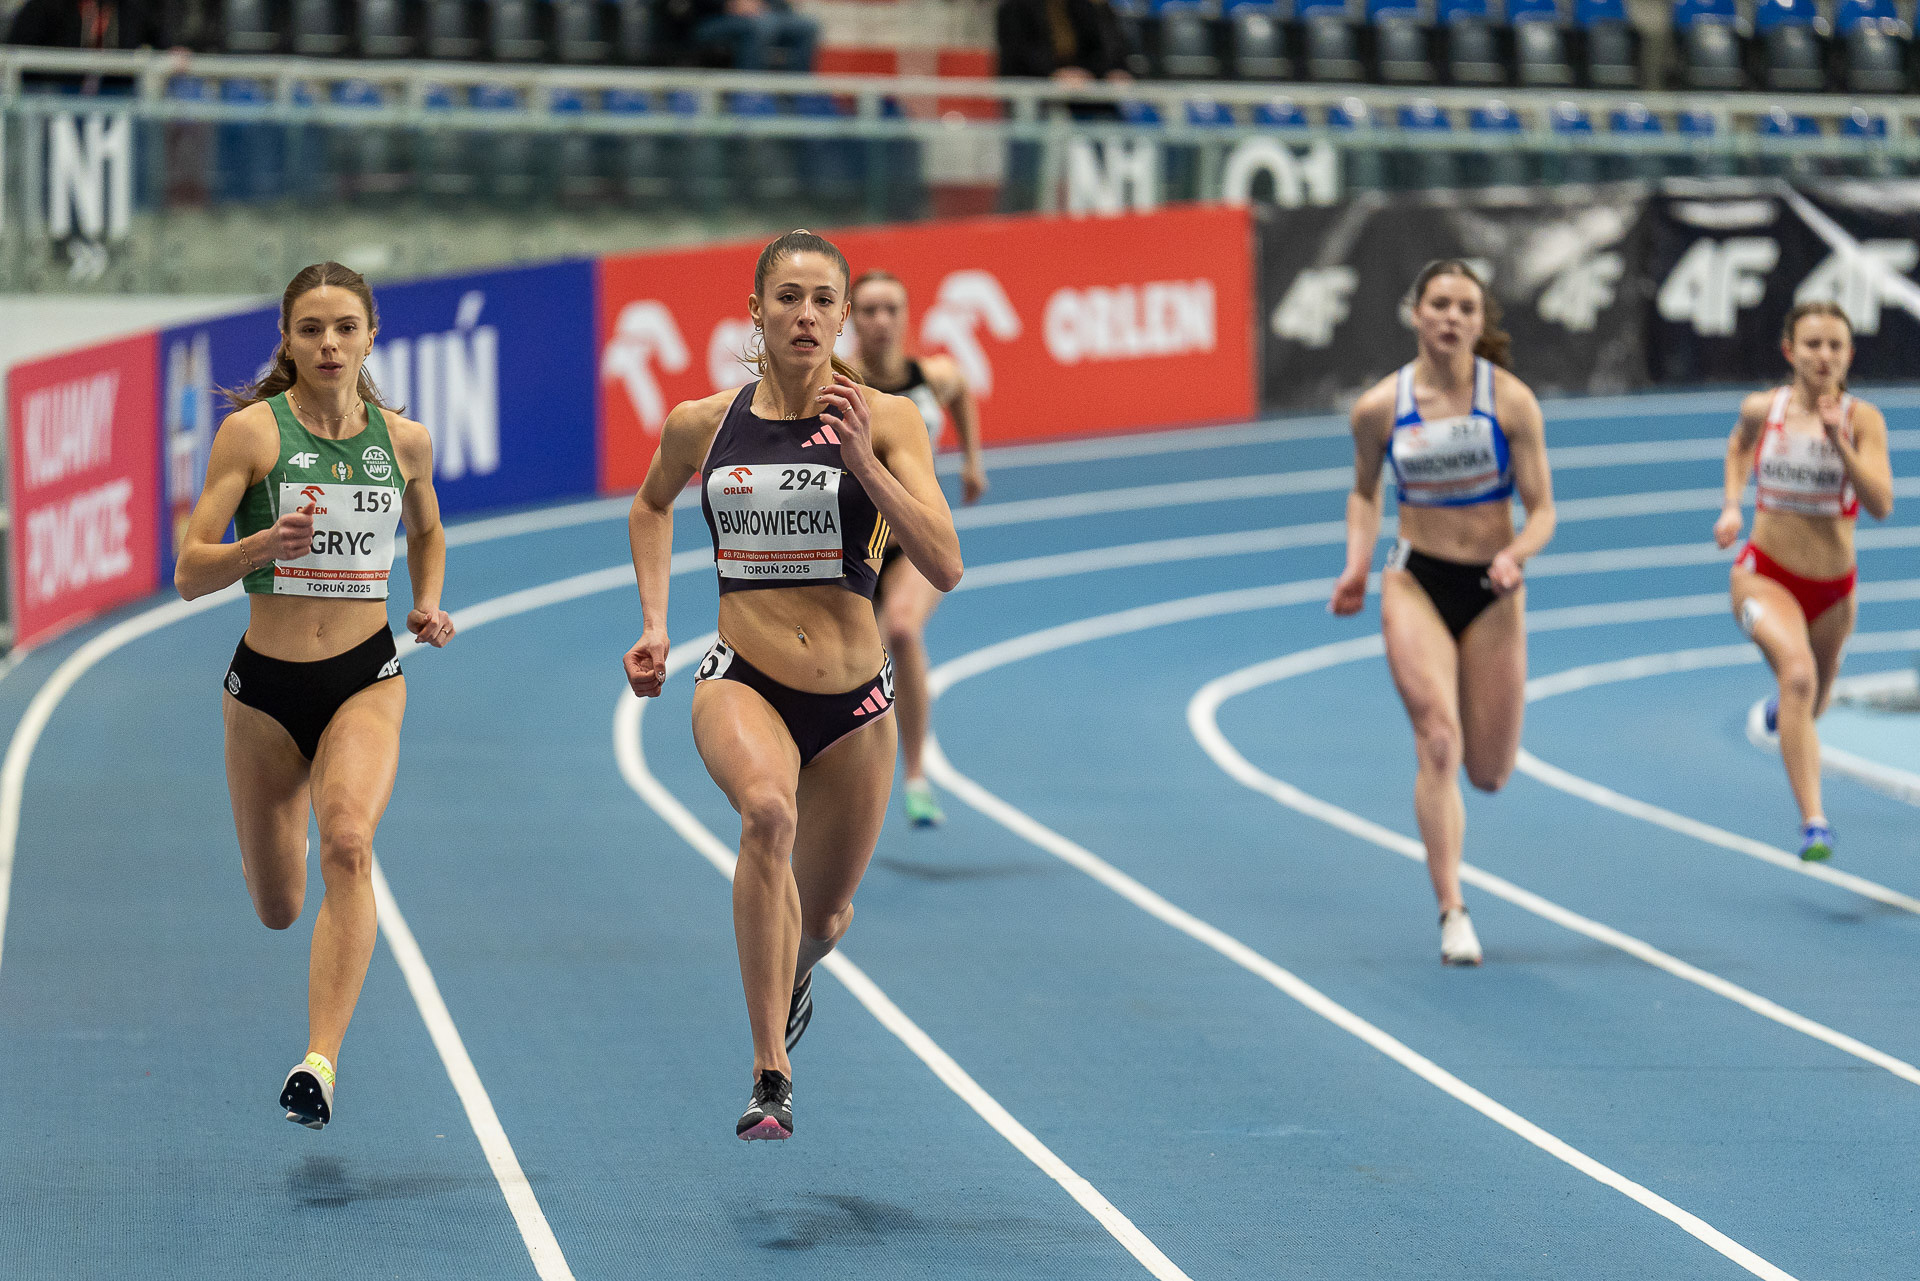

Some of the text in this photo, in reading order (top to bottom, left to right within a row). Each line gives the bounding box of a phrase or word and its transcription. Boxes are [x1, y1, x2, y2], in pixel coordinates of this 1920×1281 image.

[1655, 237, 1782, 337] 4F
[1043, 278, 1216, 364] ORLEN
[288, 452, 319, 468] 4F
[366, 451, 385, 461] AZS
[369, 464, 389, 475] AWF
[779, 469, 827, 491] 294
[723, 486, 753, 495] ORLEN
[353, 491, 392, 513] 159
[717, 509, 838, 536] BUKOWIECKA
[310, 530, 376, 556] GRYC
[745, 552, 770, 560] Halowe
[770, 552, 815, 560] Mistrzostwa
[743, 562, 810, 574] TORUŃ 2025
[306, 581, 371, 593] TORUŃ 2025
